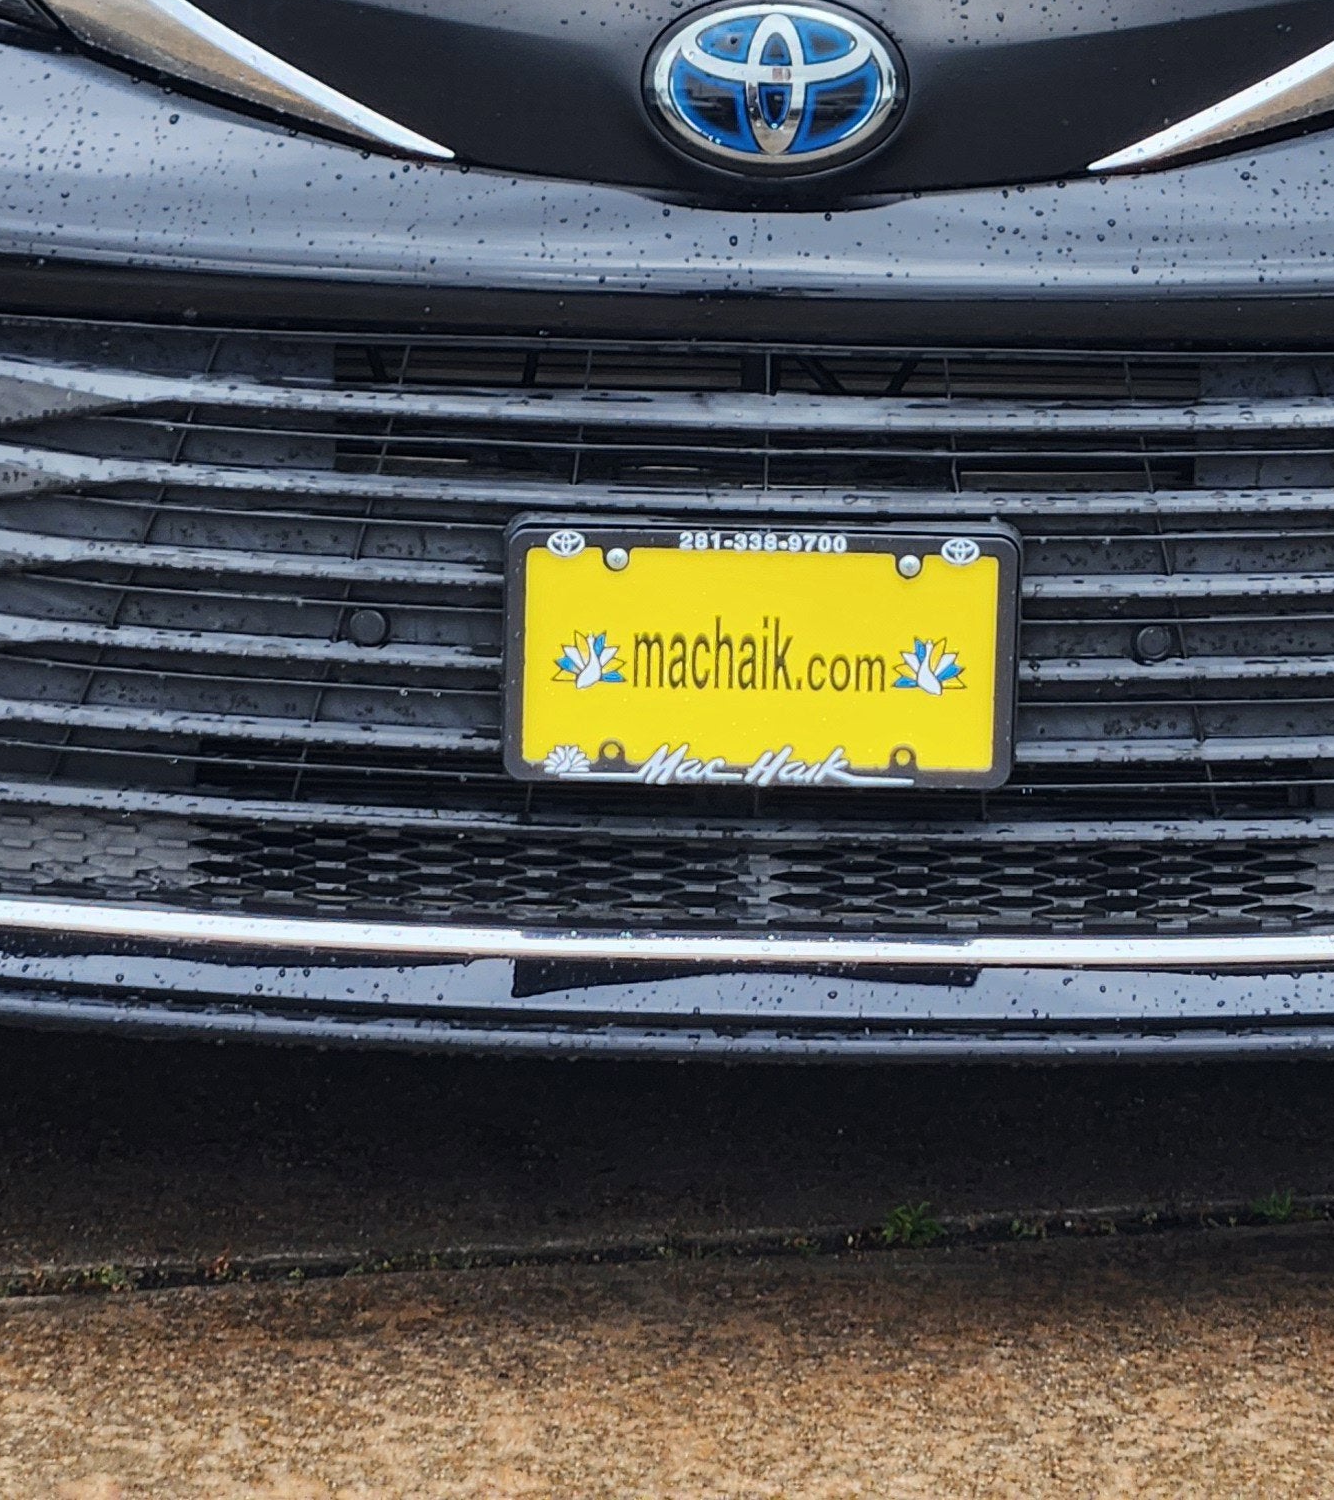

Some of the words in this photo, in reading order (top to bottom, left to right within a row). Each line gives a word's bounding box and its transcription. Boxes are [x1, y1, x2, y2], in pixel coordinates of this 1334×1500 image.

[678, 530, 848, 554] 281-338-9700
[632, 614, 887, 693] machaik.com
[635, 742, 743, 786] Mac
[744, 745, 892, 787] Haik
